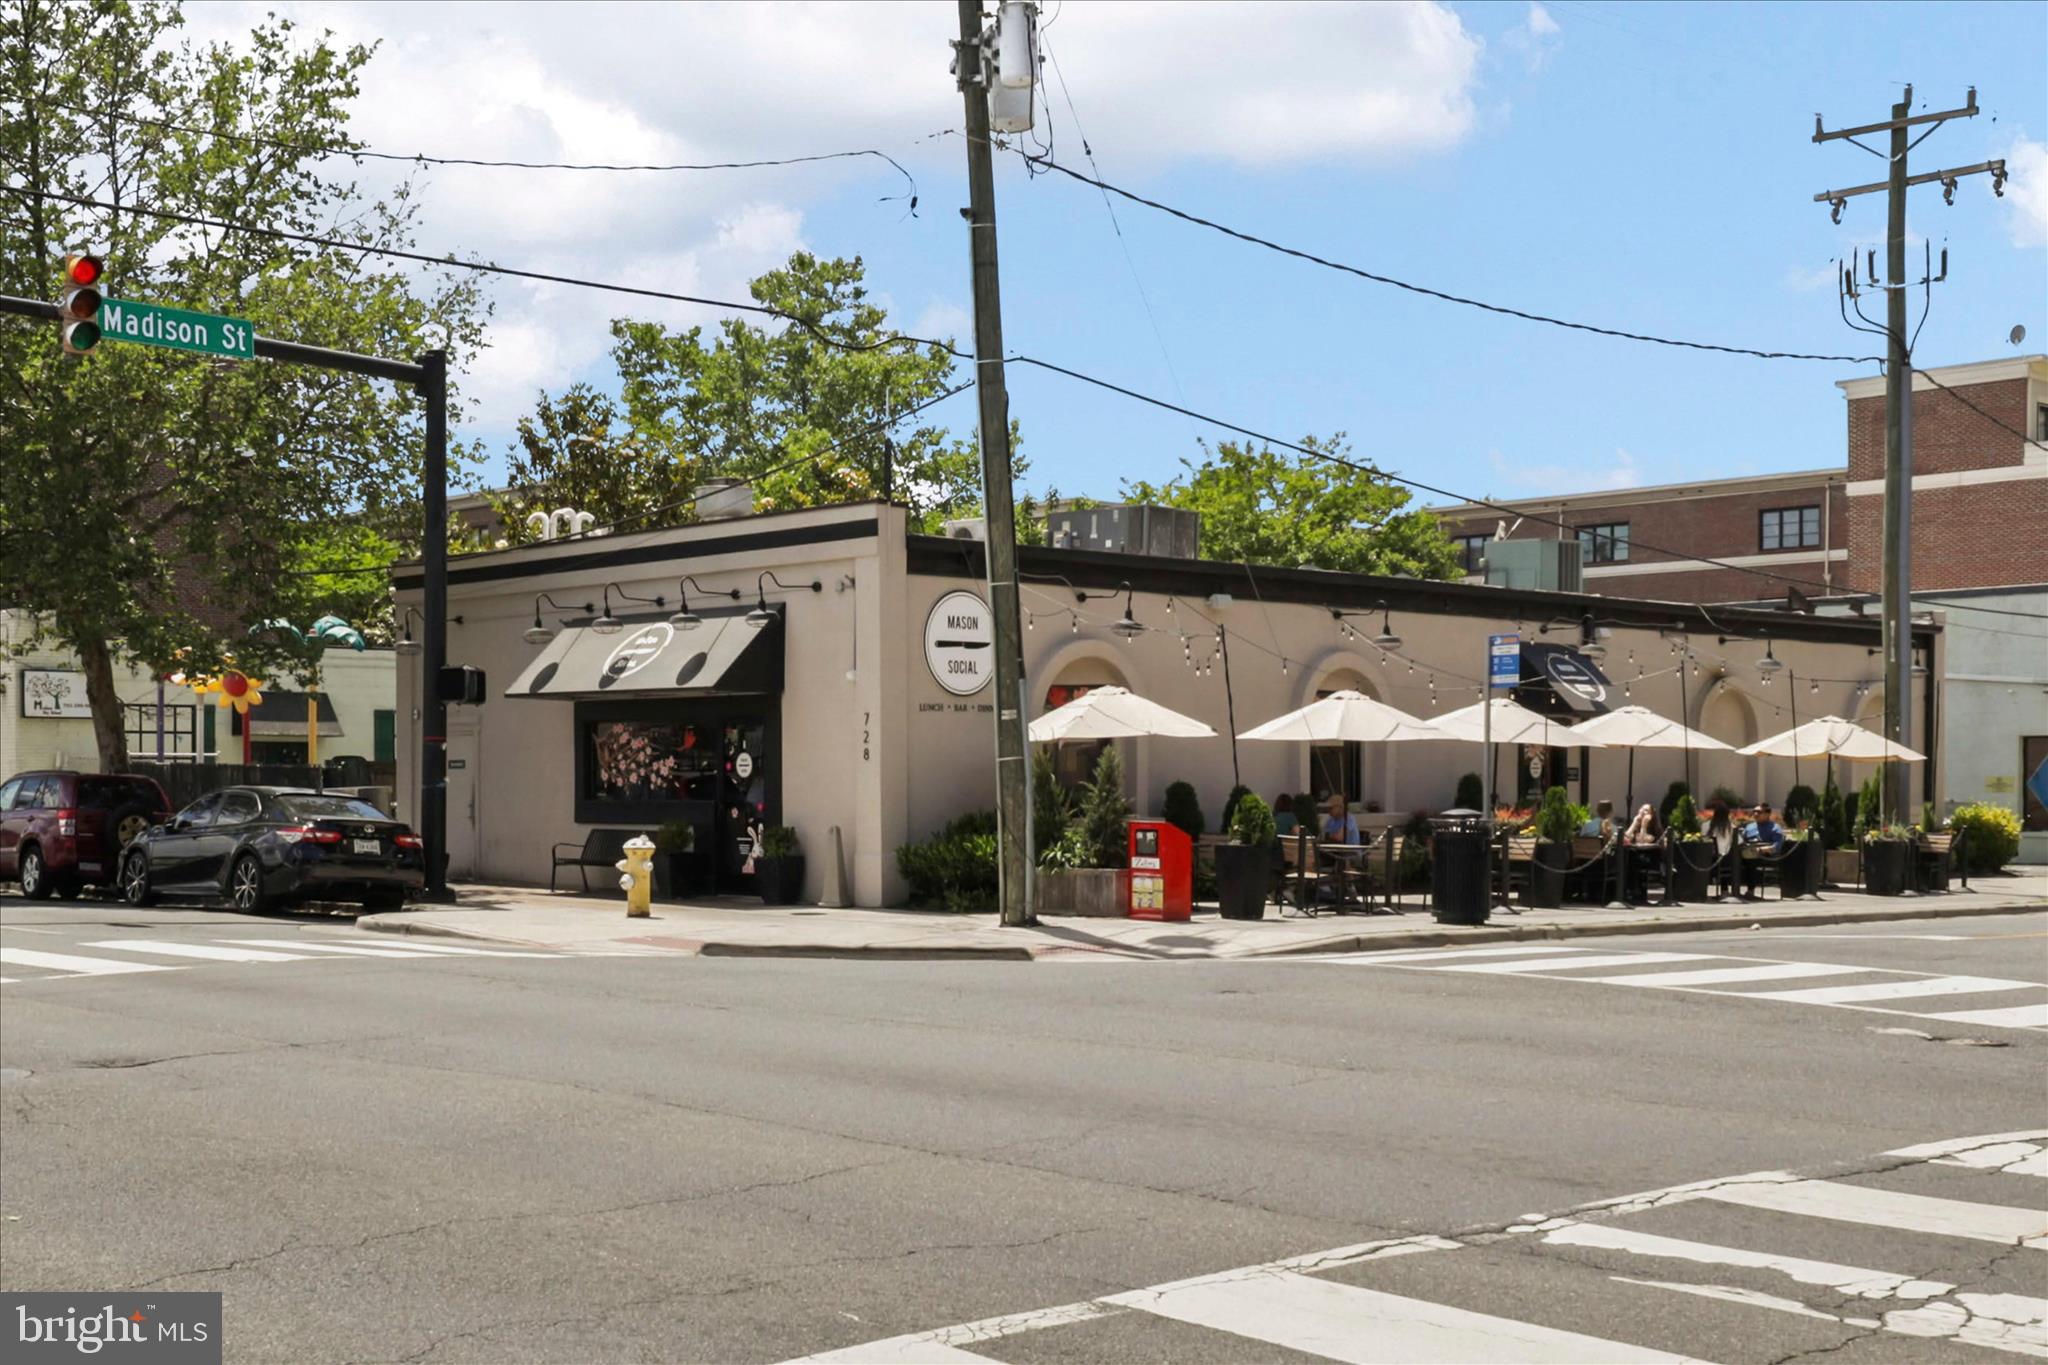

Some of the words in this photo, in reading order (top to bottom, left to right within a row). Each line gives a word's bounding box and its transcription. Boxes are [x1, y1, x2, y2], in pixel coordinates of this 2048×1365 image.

[104, 304, 208, 346] Madison
[221, 323, 247, 352] St
[947, 615, 979, 630] MASON
[947, 660, 979, 675] SOCIAL
